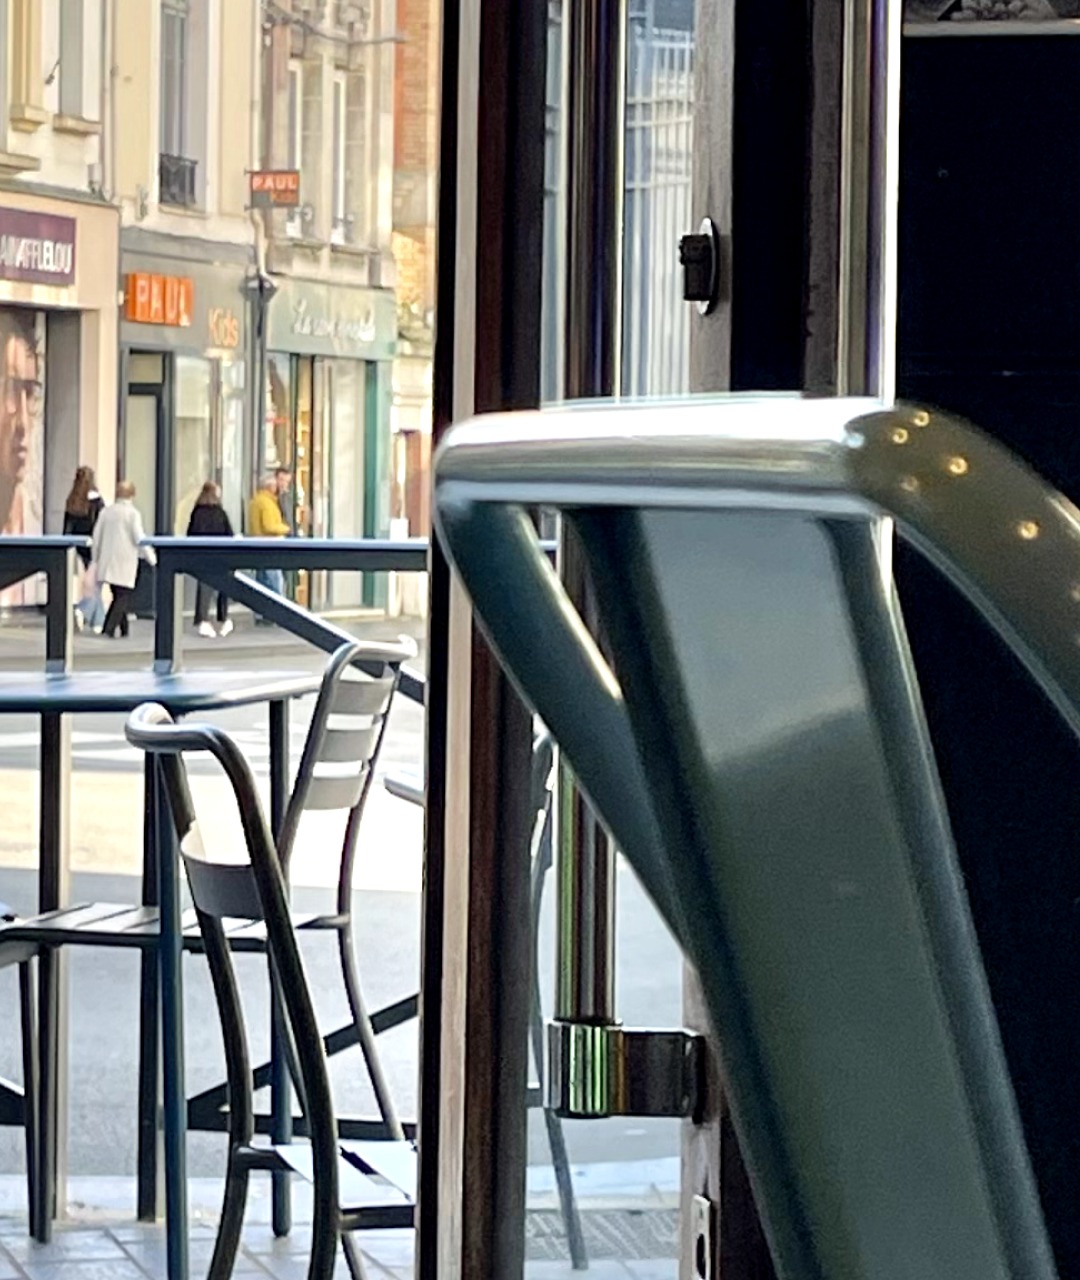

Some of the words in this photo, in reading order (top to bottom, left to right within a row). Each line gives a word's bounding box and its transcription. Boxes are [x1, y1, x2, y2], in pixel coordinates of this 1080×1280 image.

[252, 175, 297, 190] PAUL
[135, 278, 191, 327] PAUL
[208, 308, 238, 347] Kids
